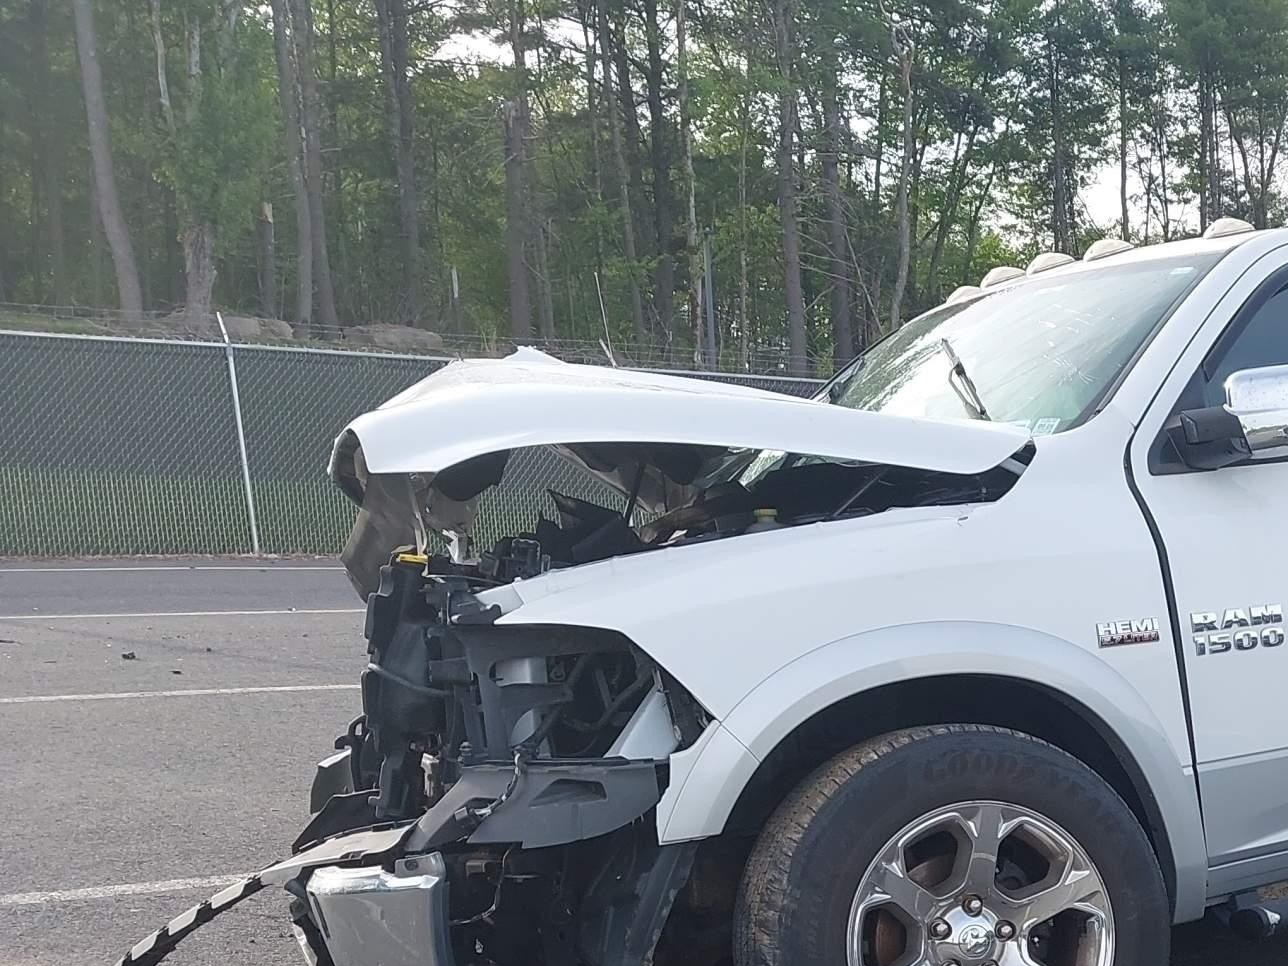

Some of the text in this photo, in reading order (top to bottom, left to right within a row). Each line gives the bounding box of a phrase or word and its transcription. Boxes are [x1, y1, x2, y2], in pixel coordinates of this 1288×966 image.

[1096, 617, 1160, 636] HEMI
[1190, 604, 1283, 633] RAM
[1192, 627, 1285, 656] 1500
